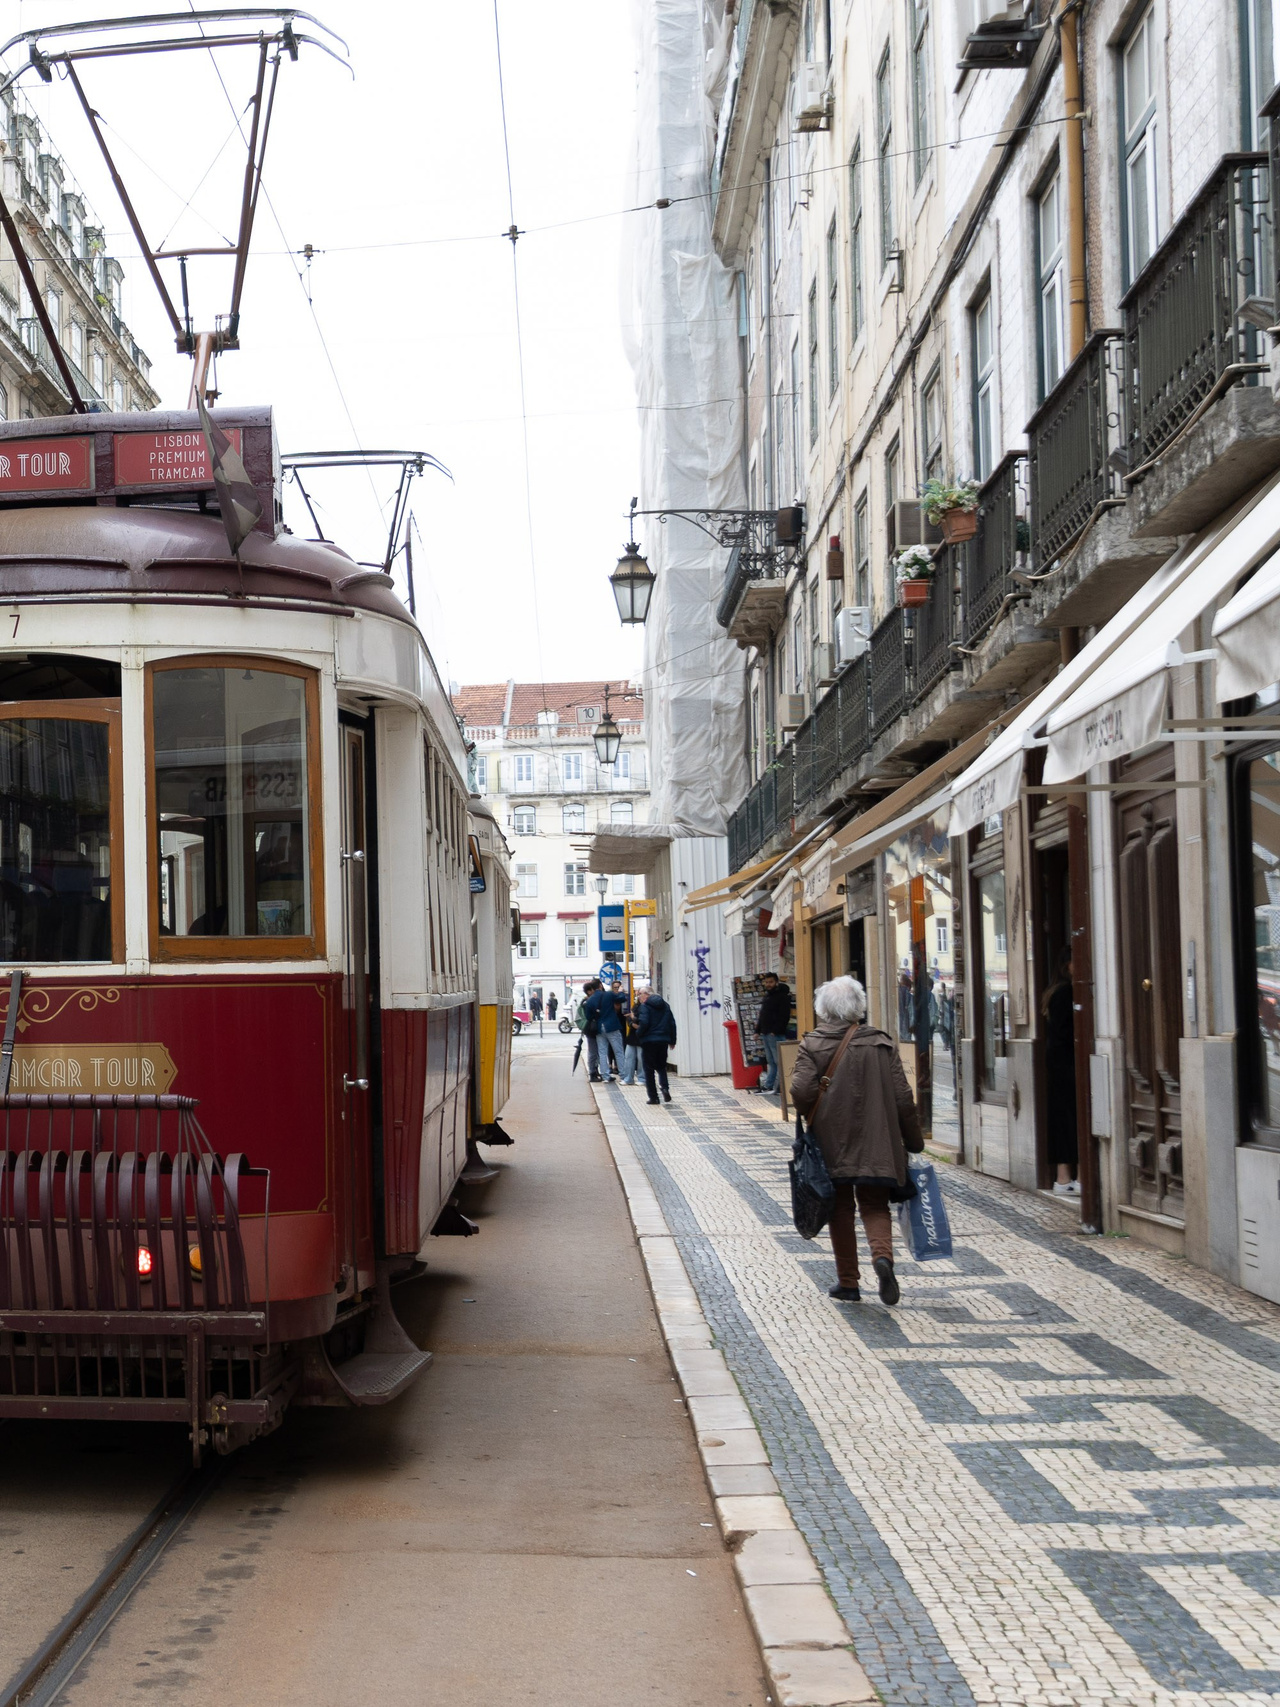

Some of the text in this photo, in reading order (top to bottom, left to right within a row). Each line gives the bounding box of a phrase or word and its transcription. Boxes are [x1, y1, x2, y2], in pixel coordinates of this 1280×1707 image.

[155, 435, 200, 448] LISBON
[17, 452, 71, 477] TOUR
[149, 450, 205, 464] PREMIUM
[149, 467, 205, 480] TRAMCAR
[9, 614, 20, 638] 7
[583, 707, 595, 719] 10
[90, 1057, 156, 1087] TOUR
[921, 1188, 939, 1247] natura
